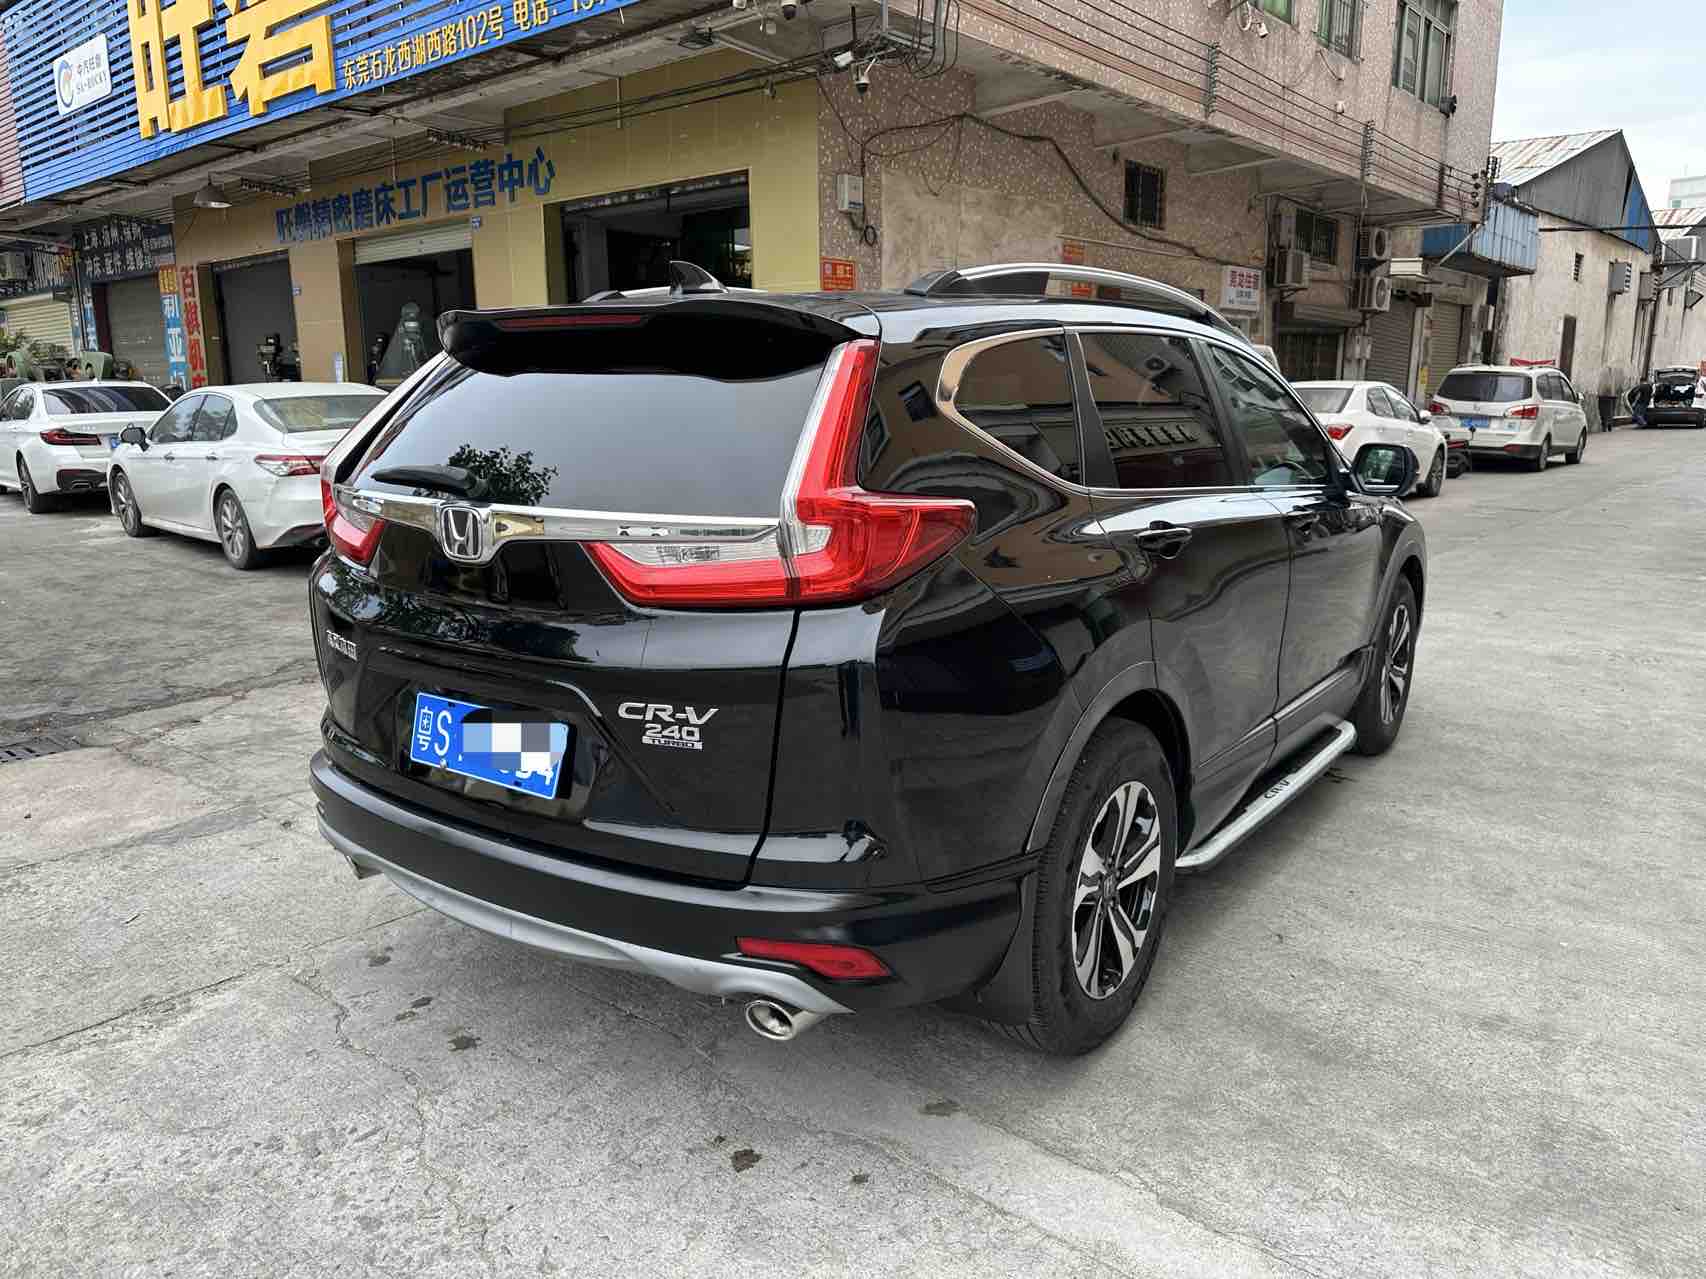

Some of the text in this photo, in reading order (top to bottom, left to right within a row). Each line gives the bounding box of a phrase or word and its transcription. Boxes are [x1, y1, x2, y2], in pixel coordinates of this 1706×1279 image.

[342, 7, 505, 90] 东莞石龙西湖西路102号
[617, 701, 720, 725] CR-V
[644, 723, 701, 741] 240
